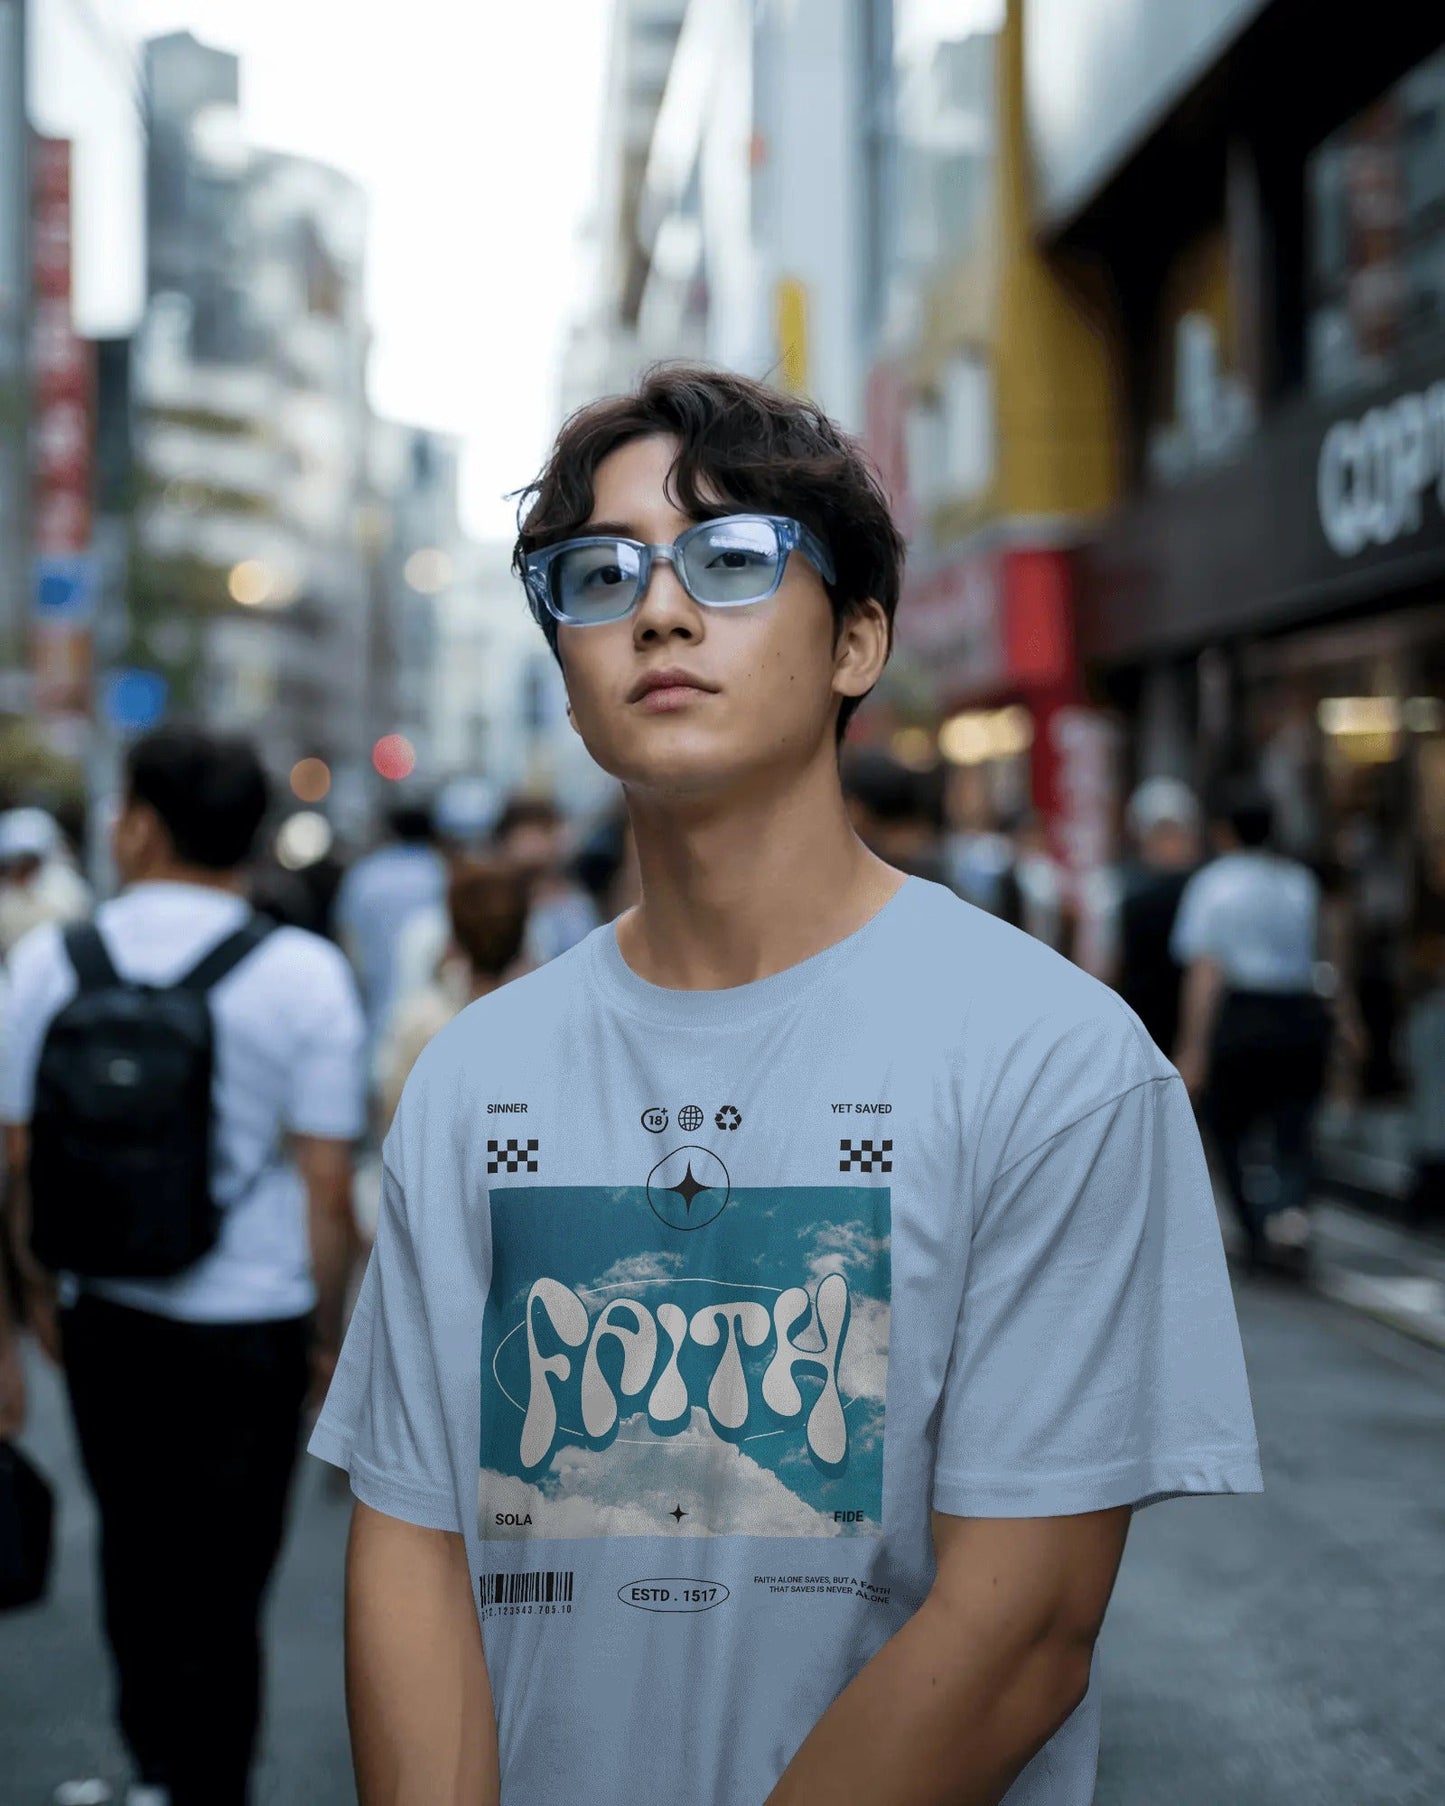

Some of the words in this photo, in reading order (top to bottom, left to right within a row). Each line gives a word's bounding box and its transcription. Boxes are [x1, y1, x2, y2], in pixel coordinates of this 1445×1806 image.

[487, 1103, 528, 1114] SINNER
[831, 1103, 853, 1114] YET
[855, 1103, 892, 1114] SAVED
[519, 1272, 851, 1472] FAITH
[495, 1513, 533, 1526] SOLA
[834, 1510, 864, 1522] FIDE
[754, 1576, 776, 1584] FAITH
[778, 1576, 803, 1584] ALONE
[805, 1576, 832, 1585] SAVES,
[833, 1576, 849, 1584] BUT
[850, 1577, 858, 1586] A
[860, 1580, 891, 1595] FAITH
[683, 1588, 717, 1602] 1517
[769, 1585, 789, 1593] THAT
[791, 1585, 815, 1593] SAVES
[817, 1585, 825, 1593] IS
[826, 1585, 853, 1594] NEVER
[855, 1589, 890, 1604] ALONE
